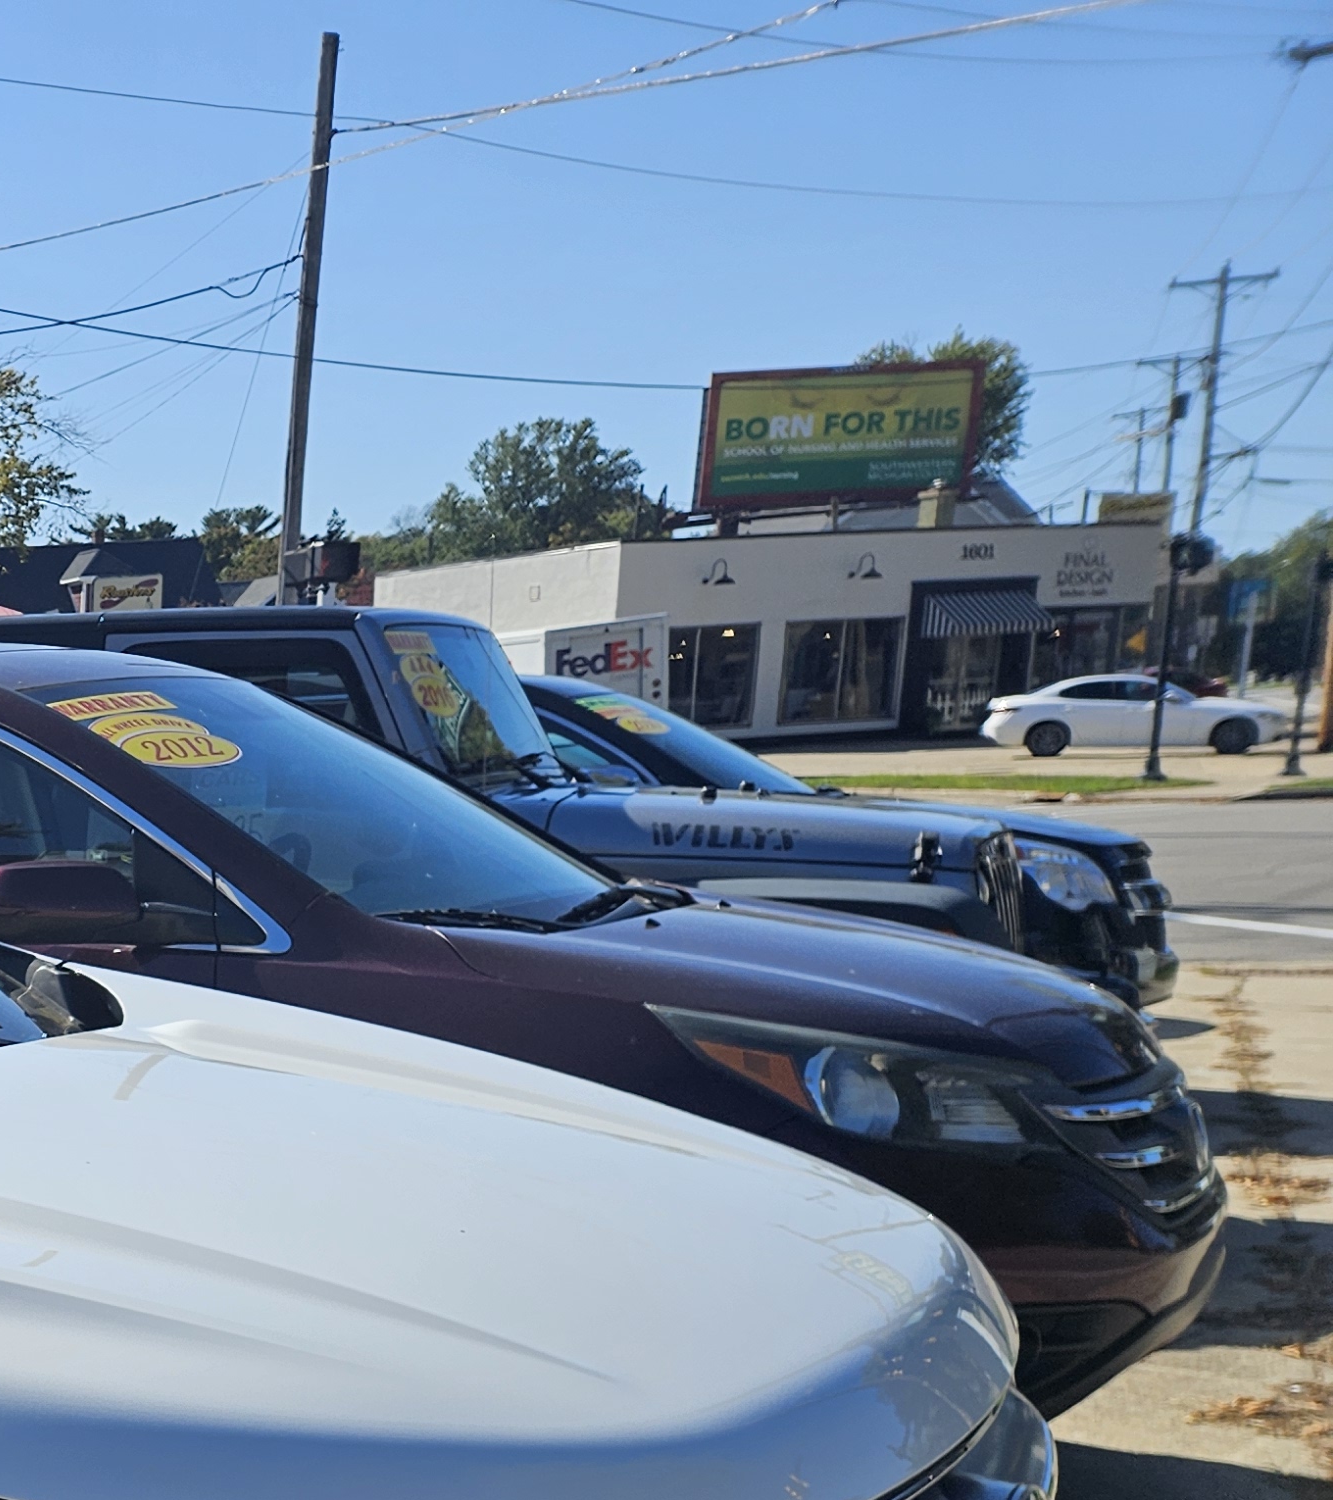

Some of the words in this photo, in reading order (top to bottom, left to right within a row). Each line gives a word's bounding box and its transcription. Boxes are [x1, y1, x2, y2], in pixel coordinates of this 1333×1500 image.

[725, 413, 814, 441] BORN
[823, 411, 886, 436] FOR
[894, 407, 961, 432] THIS
[723, 445, 767, 458] SCHOOL
[770, 444, 785, 455] OF
[1064, 551, 1108, 568] FINAL
[1056, 569, 1114, 587] DESIGN
[556, 640, 653, 678] FedEx
[52, 694, 166, 717] WARRANTY
[115, 718, 150, 731] WHEEL
[141, 736, 225, 762] 2012
[651, 821, 800, 851] WILLYS
